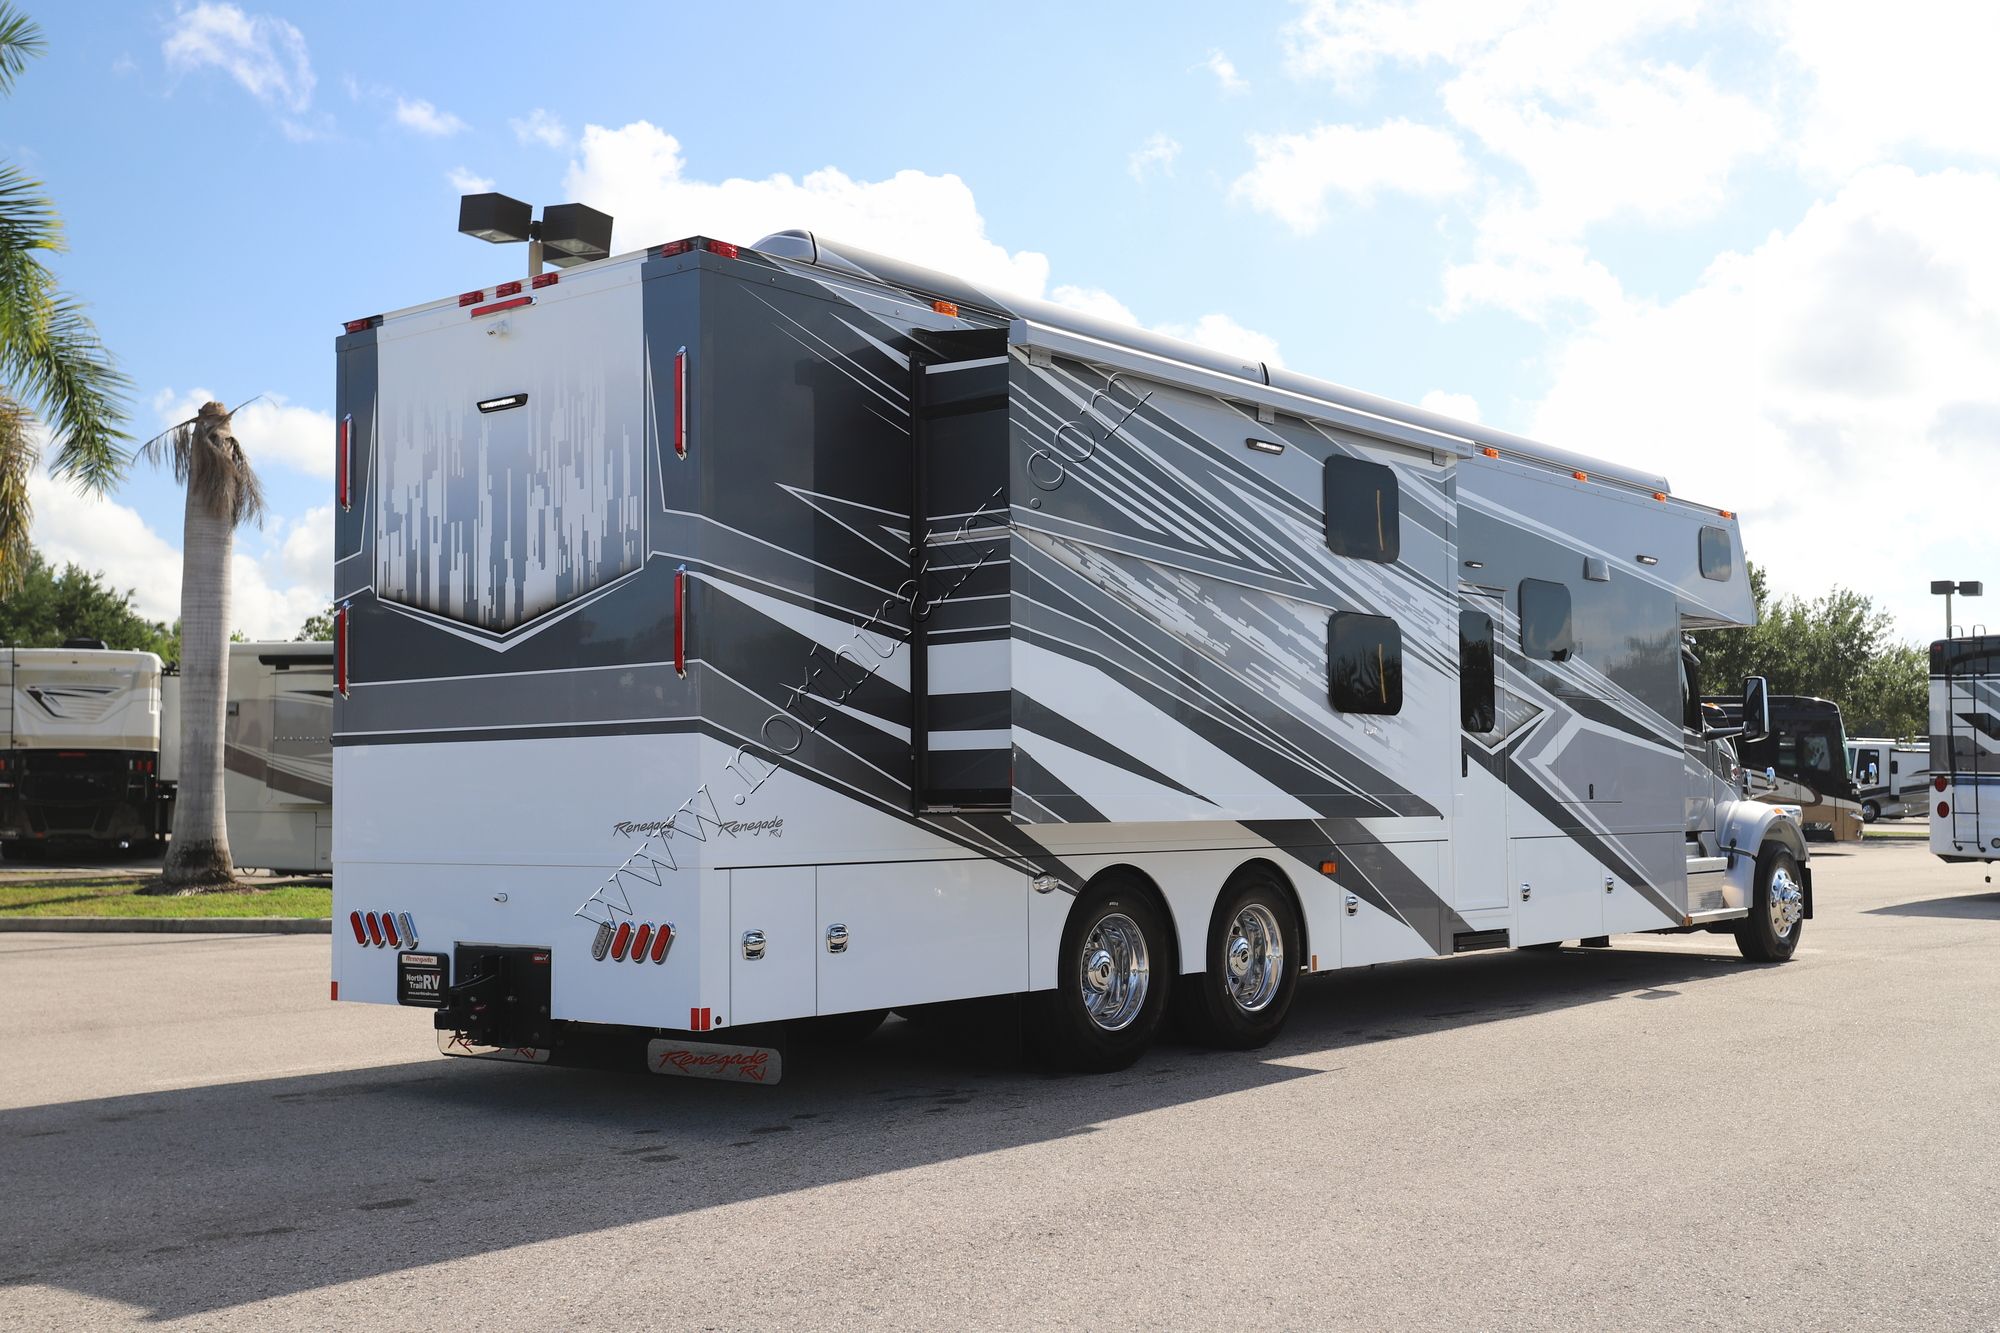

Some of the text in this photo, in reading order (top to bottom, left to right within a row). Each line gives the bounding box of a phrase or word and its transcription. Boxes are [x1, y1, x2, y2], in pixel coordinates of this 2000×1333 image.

[717, 815, 784, 839] Renegade
[406, 974, 423, 982] North
[409, 981, 423, 990] Trail
[423, 974, 440, 990] RV
[658, 1049, 769, 1074] Renegade
